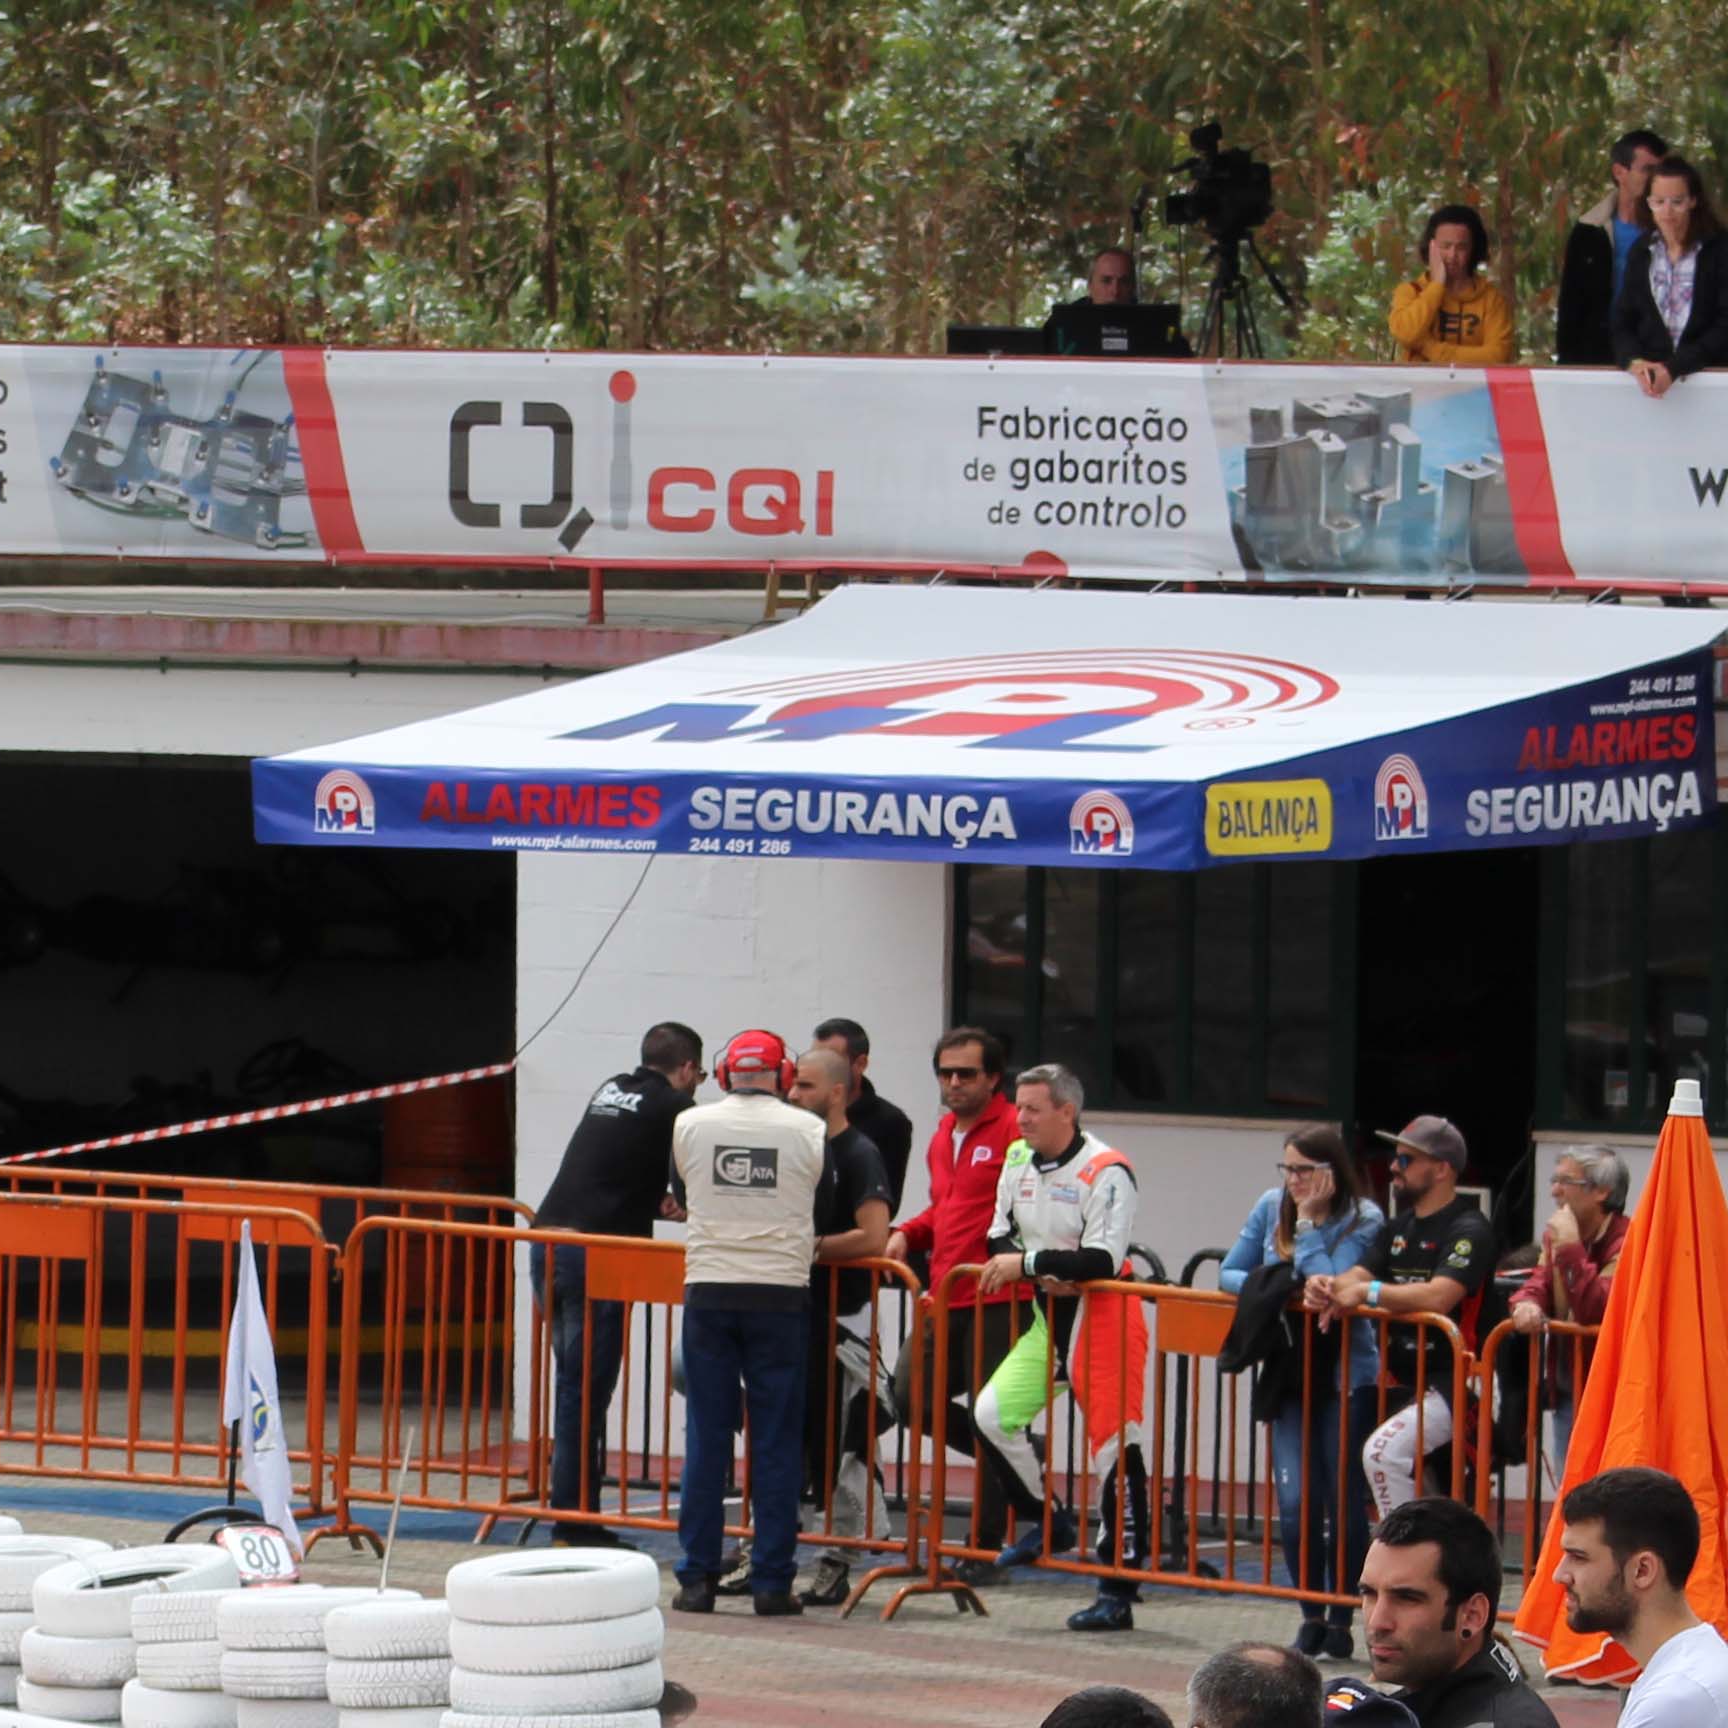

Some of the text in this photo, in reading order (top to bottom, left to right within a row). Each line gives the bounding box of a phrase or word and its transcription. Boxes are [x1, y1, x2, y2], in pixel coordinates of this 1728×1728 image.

[976, 405, 1188, 451] Fabricação
[963, 449, 1188, 491] de gabaritos
[646, 466, 835, 537] CQI
[987, 495, 1188, 530] de controlo
[1516, 713, 1697, 772] ALARMES
[418, 782, 663, 829] ALARMES
[688, 786, 1018, 849] SEGURANÇA
[1217, 796, 1320, 844] BALANÇA
[1464, 770, 1703, 838] SEGURANÇA
[491, 833, 658, 852] www.mpl-alarmes.com
[688, 837, 792, 856] 244 491 286
[240, 1535, 281, 1571] 80
